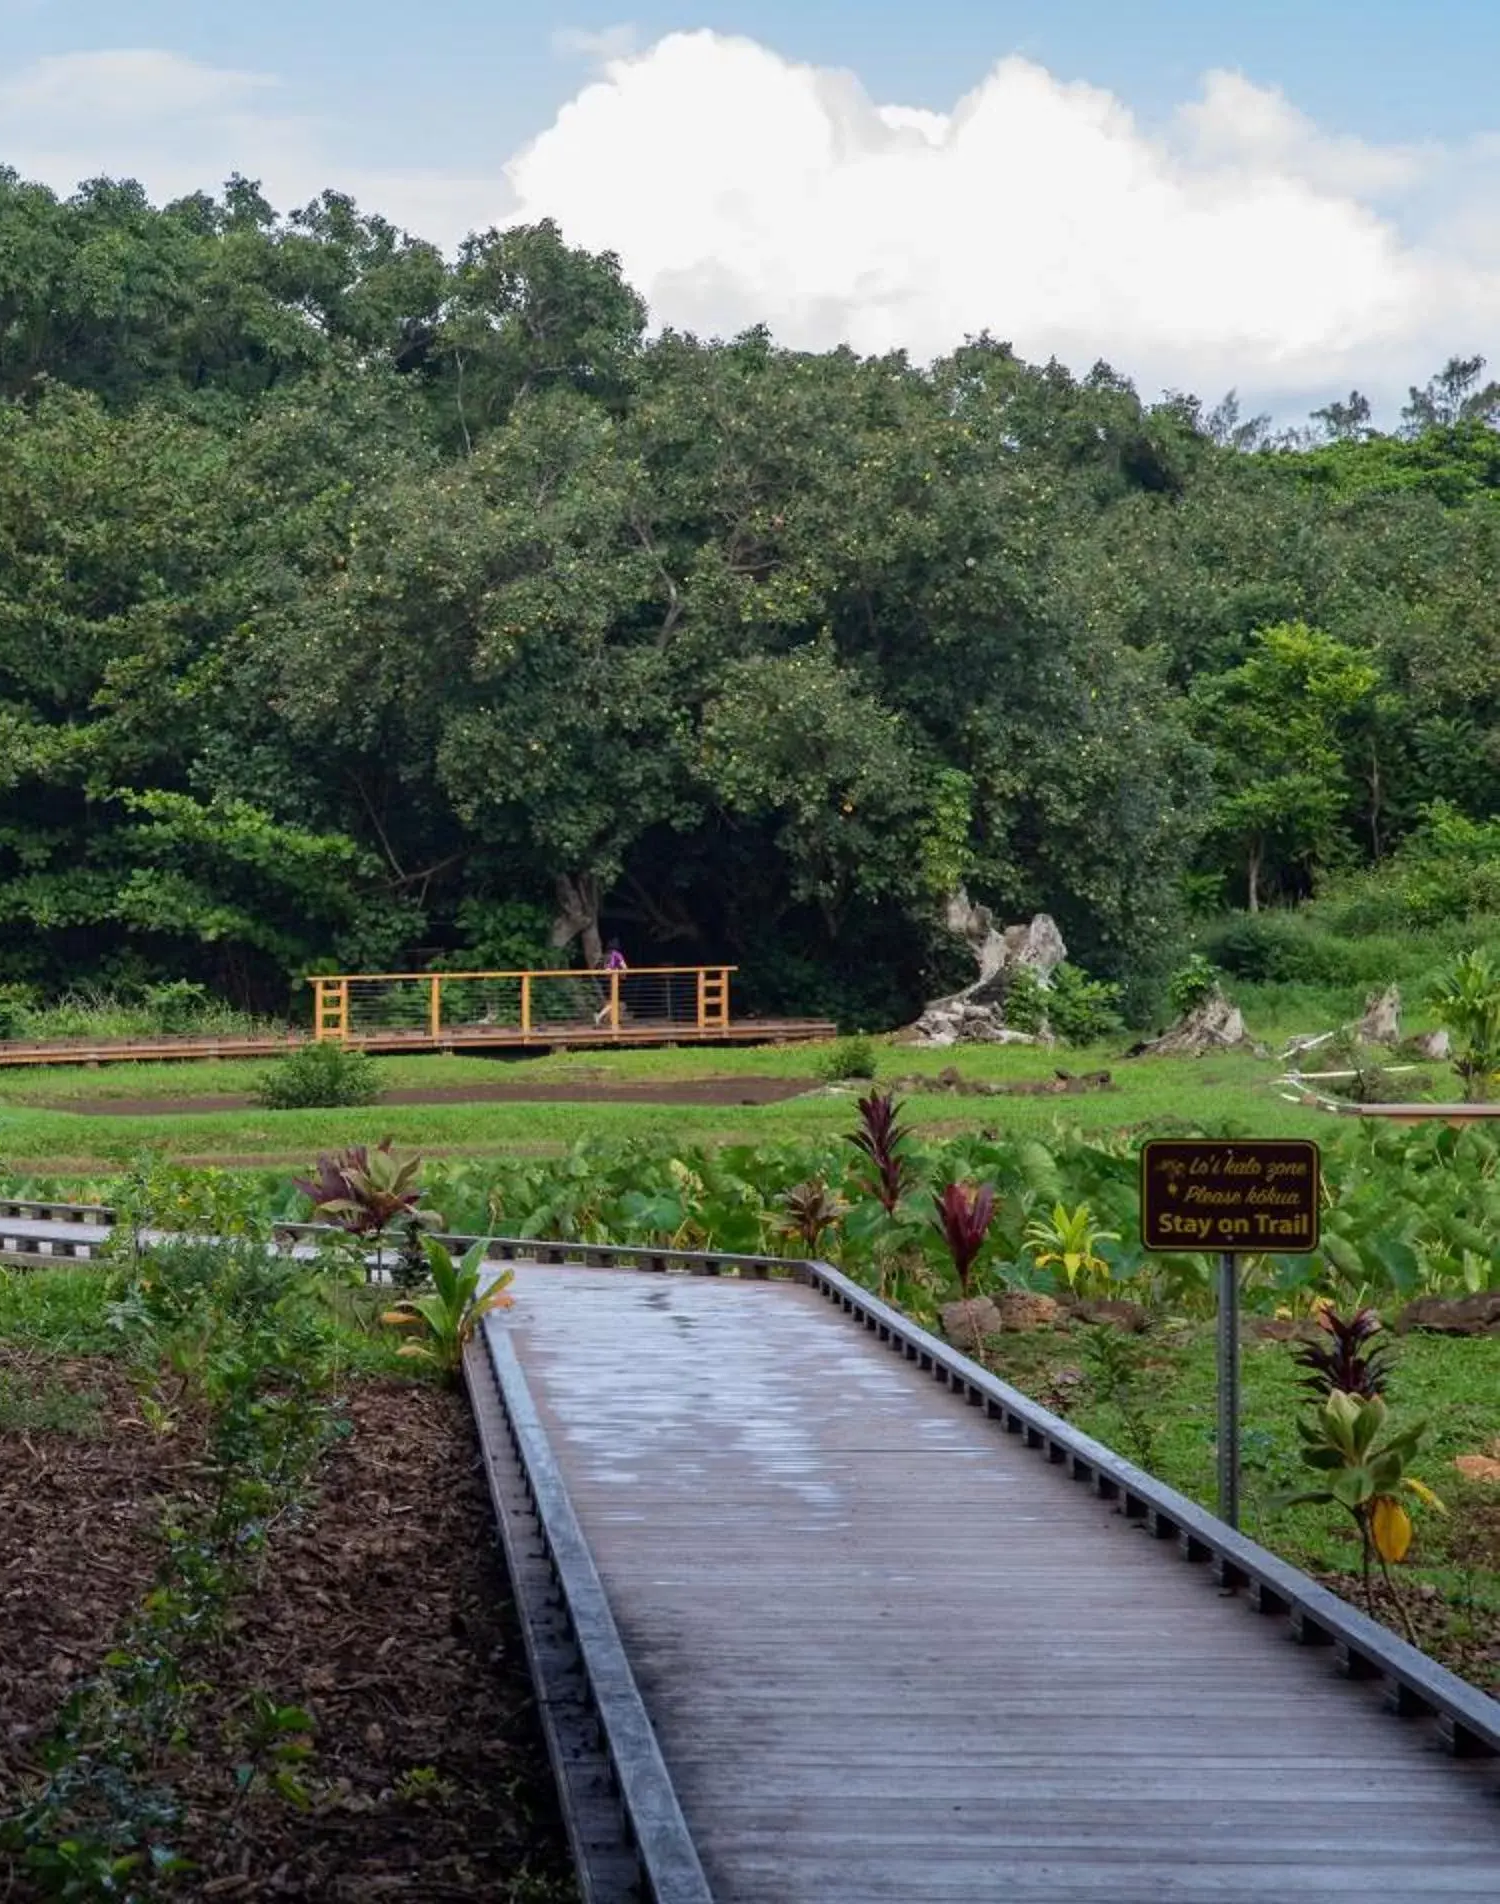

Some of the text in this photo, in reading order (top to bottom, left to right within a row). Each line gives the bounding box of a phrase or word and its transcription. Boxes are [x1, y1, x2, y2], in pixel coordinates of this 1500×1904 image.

[1184, 1184, 1241, 1205] Please
[1158, 1213, 1309, 1238] Stay on Trail
